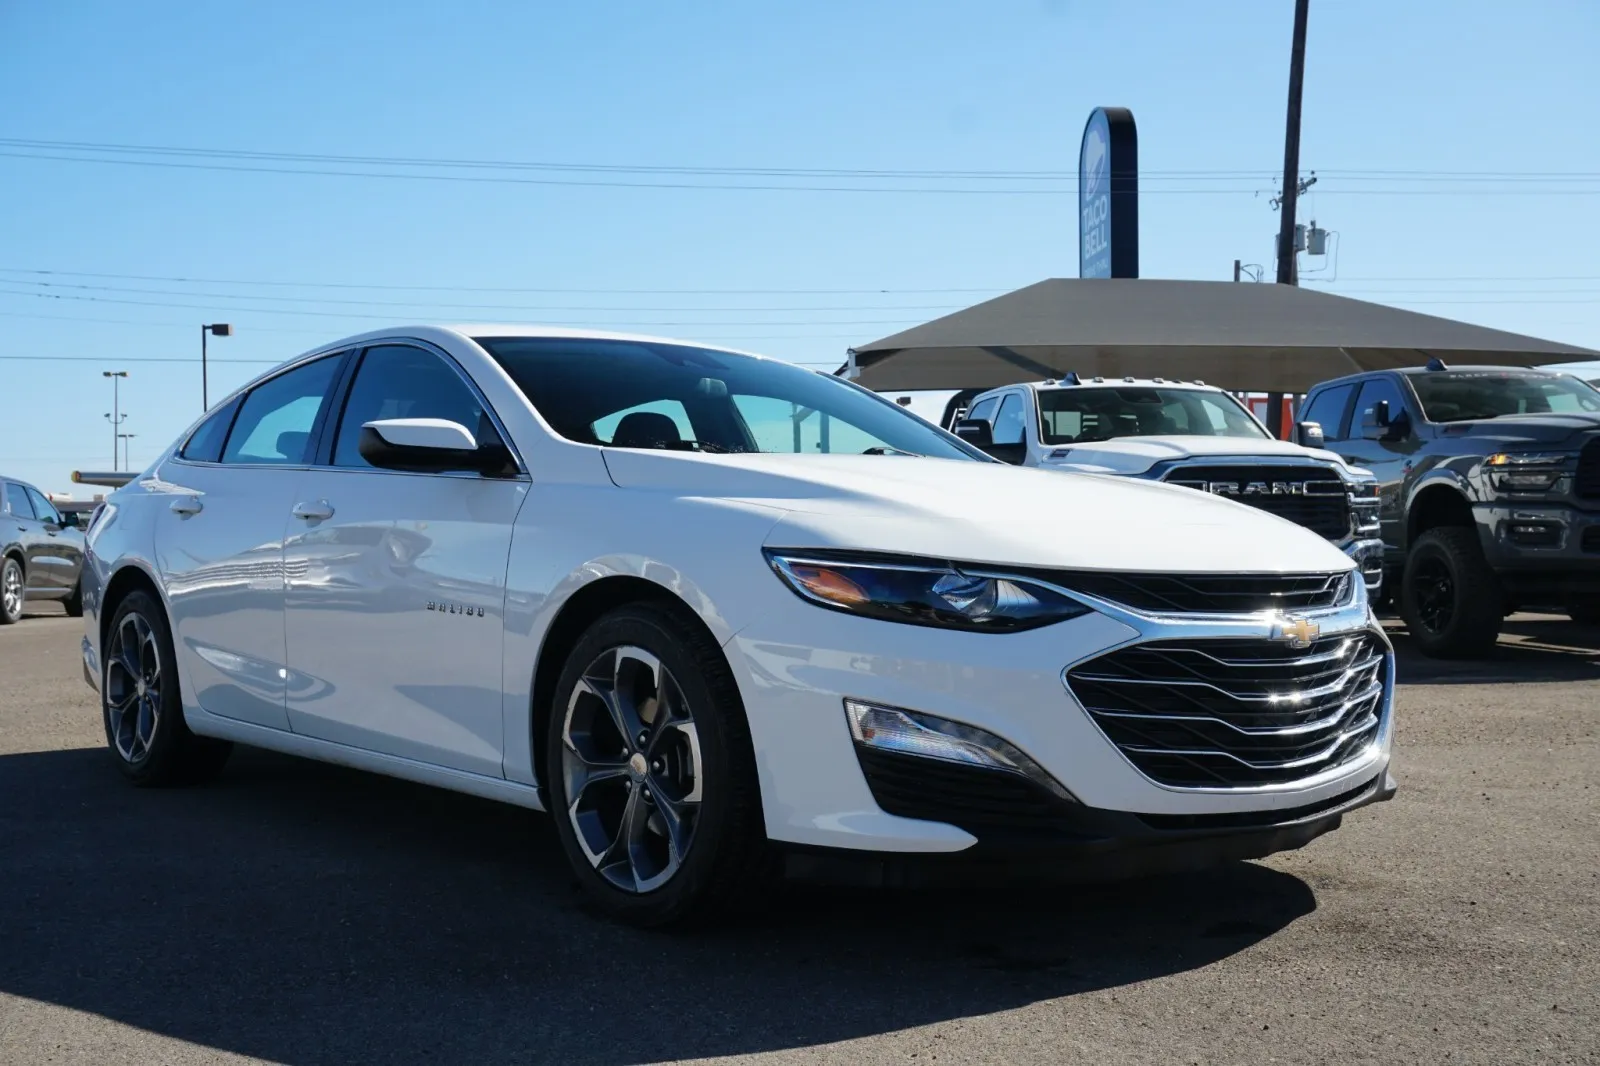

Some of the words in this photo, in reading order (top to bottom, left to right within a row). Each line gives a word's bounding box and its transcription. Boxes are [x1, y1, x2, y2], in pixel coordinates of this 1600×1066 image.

[1083, 195, 1107, 232] TACO
[1084, 223, 1107, 260] BELL
[1210, 482, 1302, 494] RAM
[427, 601, 485, 618] MALIBU
